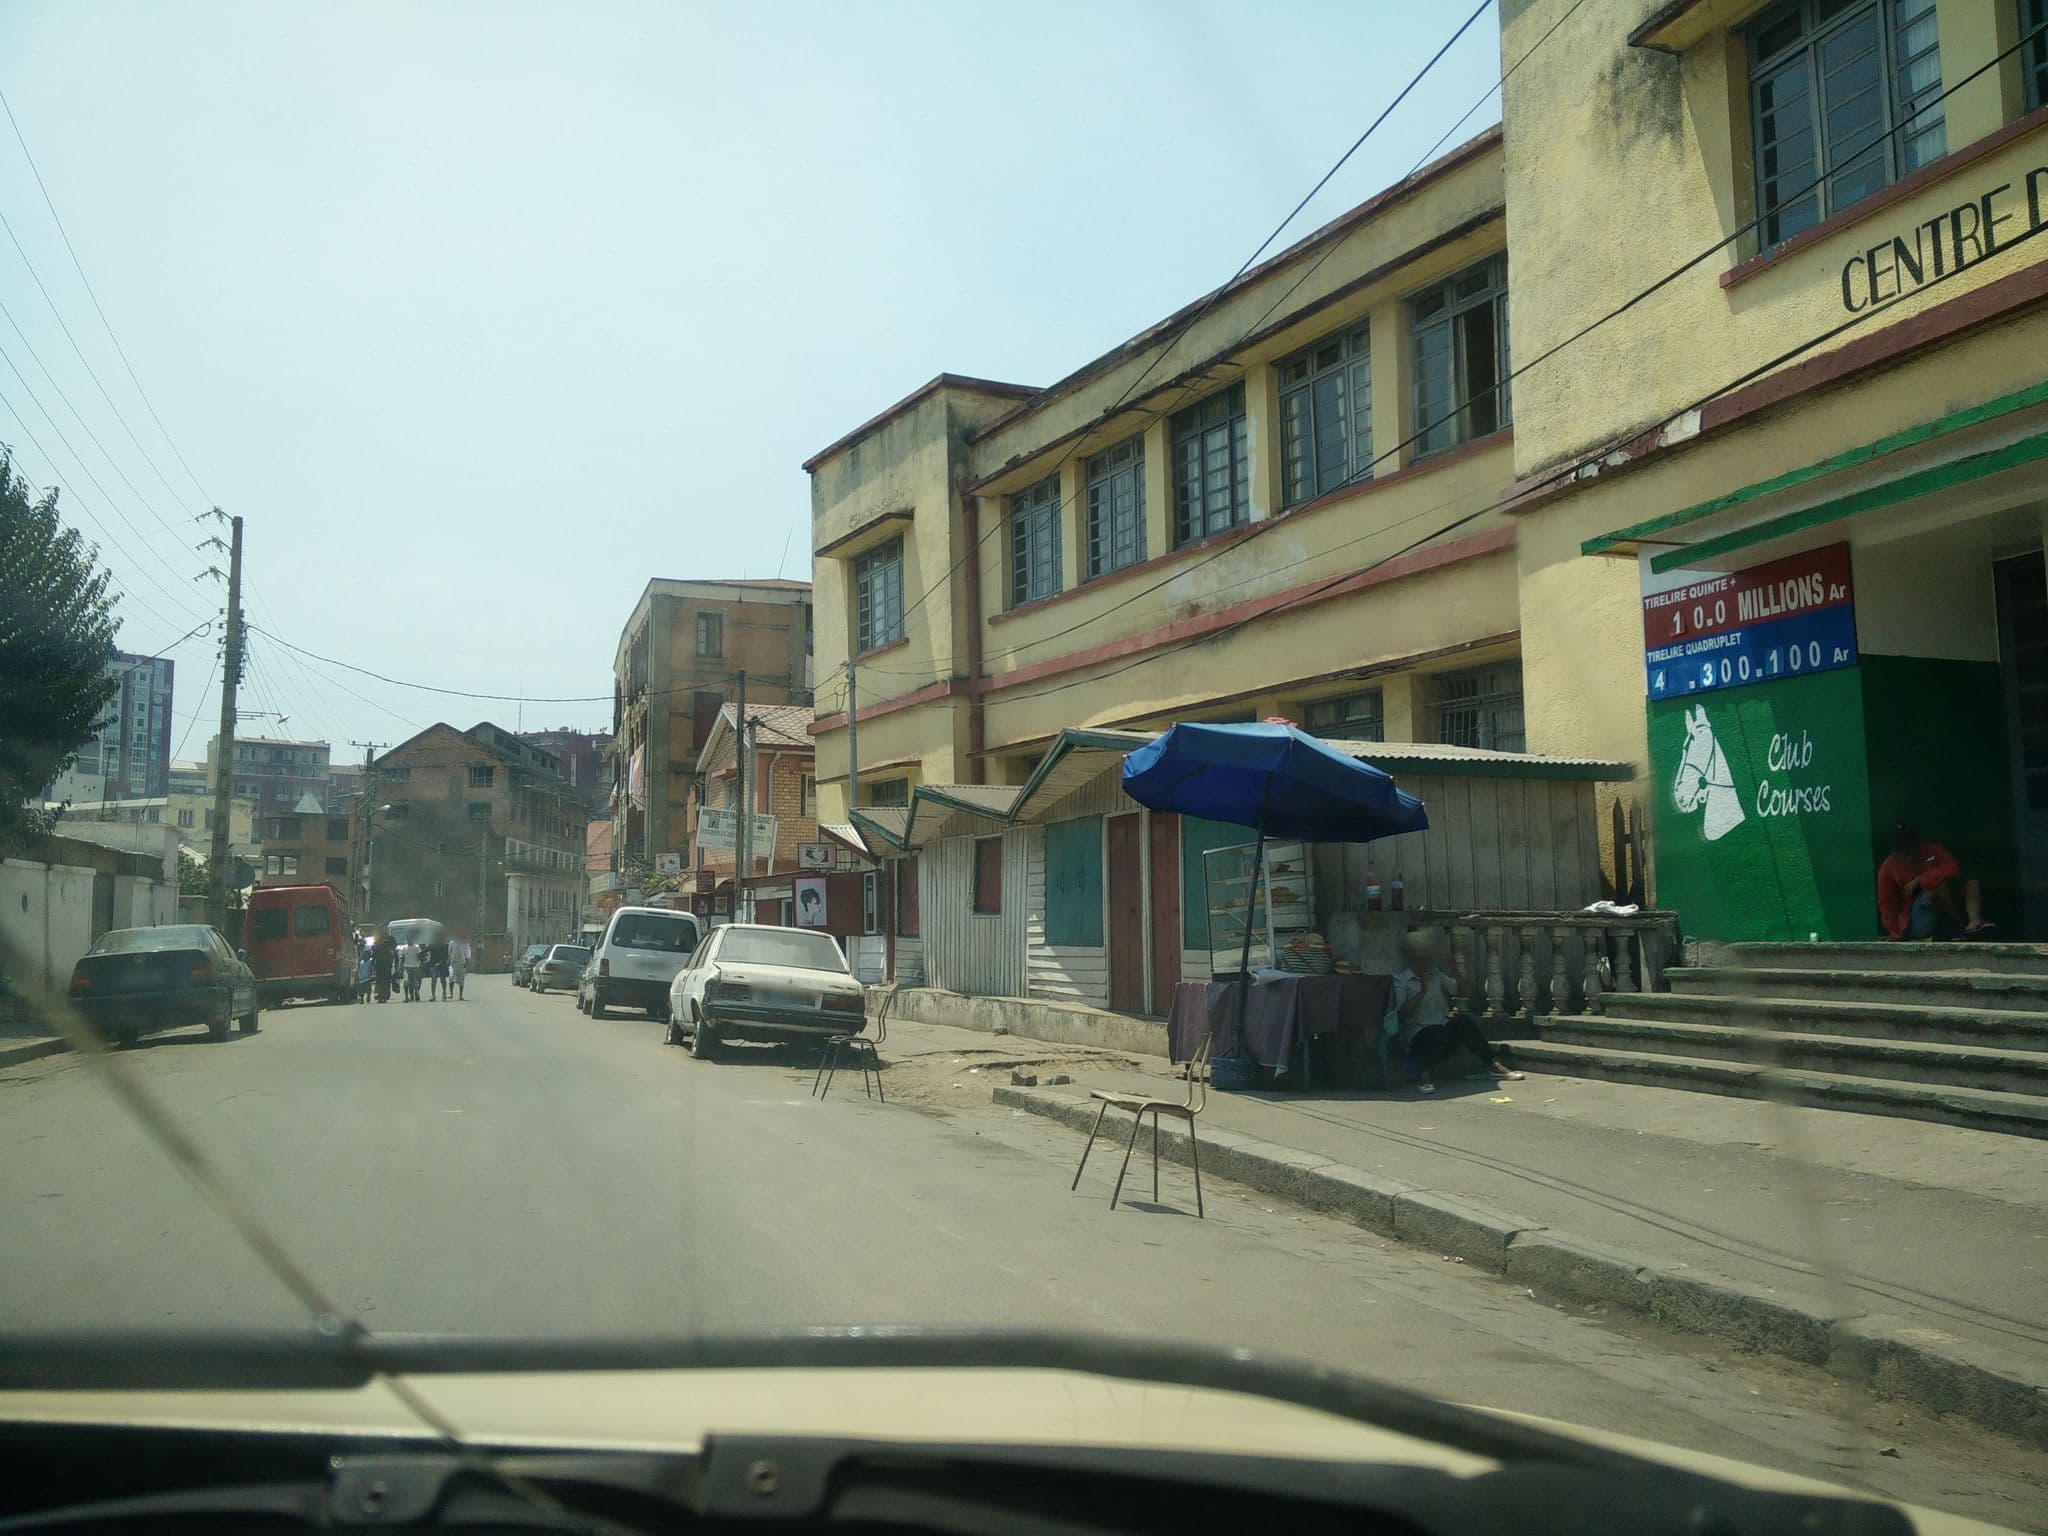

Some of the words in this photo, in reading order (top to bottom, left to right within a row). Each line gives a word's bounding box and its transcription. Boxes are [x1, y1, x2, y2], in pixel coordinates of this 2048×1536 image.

[1842, 183, 2013, 312] CENTRE
[1644, 589, 1687, 610] TIRELIRE
[1689, 578, 1728, 599] QUINTE
[1737, 572, 1825, 621] MILLIONS
[1829, 583, 1846, 601] Ar
[1647, 645, 1684, 663] TIRELIRE
[1685, 632, 1742, 655] QUADRUPLET
[1833, 647, 1850, 664] Ar
[1768, 729, 1813, 772] Club
[1756, 779, 1831, 818] Courses
